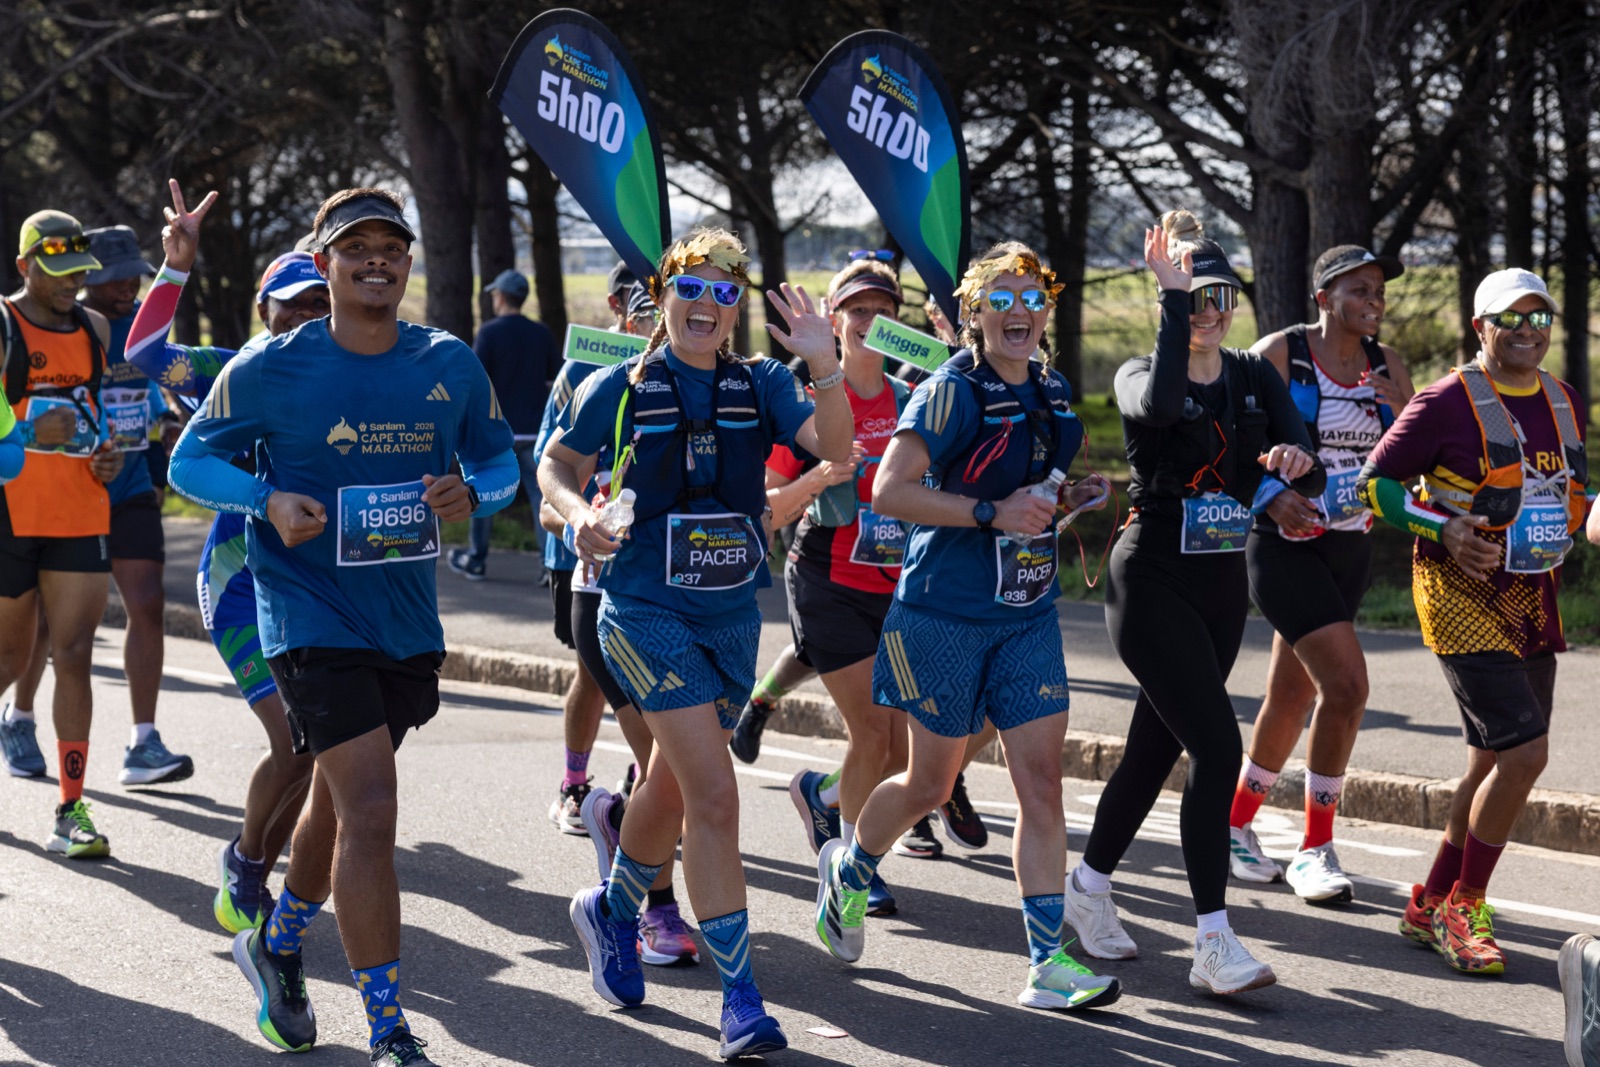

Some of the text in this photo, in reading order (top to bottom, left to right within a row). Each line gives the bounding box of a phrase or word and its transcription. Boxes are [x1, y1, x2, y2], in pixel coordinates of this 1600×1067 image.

[562, 63, 608, 90] MARATHON
[563, 53, 609, 80] CAPE TOWN
[881, 73, 900, 91] CAPE
[537, 70, 626, 154] 5h00
[846, 84, 931, 174] 5h00
[576, 336, 644, 358] Natash
[876, 326, 931, 358] Maggs
[369, 421, 435, 431] Sanlam 2026
[361, 431, 435, 443] CAPE TOWN
[361, 442, 433, 454] MARATHON
[380, 490, 419, 503] Sanlam
[358, 503, 426, 529] 19696
[708, 531, 747, 541] CAPE TOWN
[1408, 521, 1438, 542] SOUTH
[1525, 523, 1569, 543] 18522
[383, 539, 419, 547] MARATHON
[708, 538, 748, 547] MARATHON
[690, 547, 747, 567] PACER
[1017, 562, 1053, 584] PACER
[1004, 590, 1028, 602] 936
[702, 915, 743, 932] CAPE TOWN
